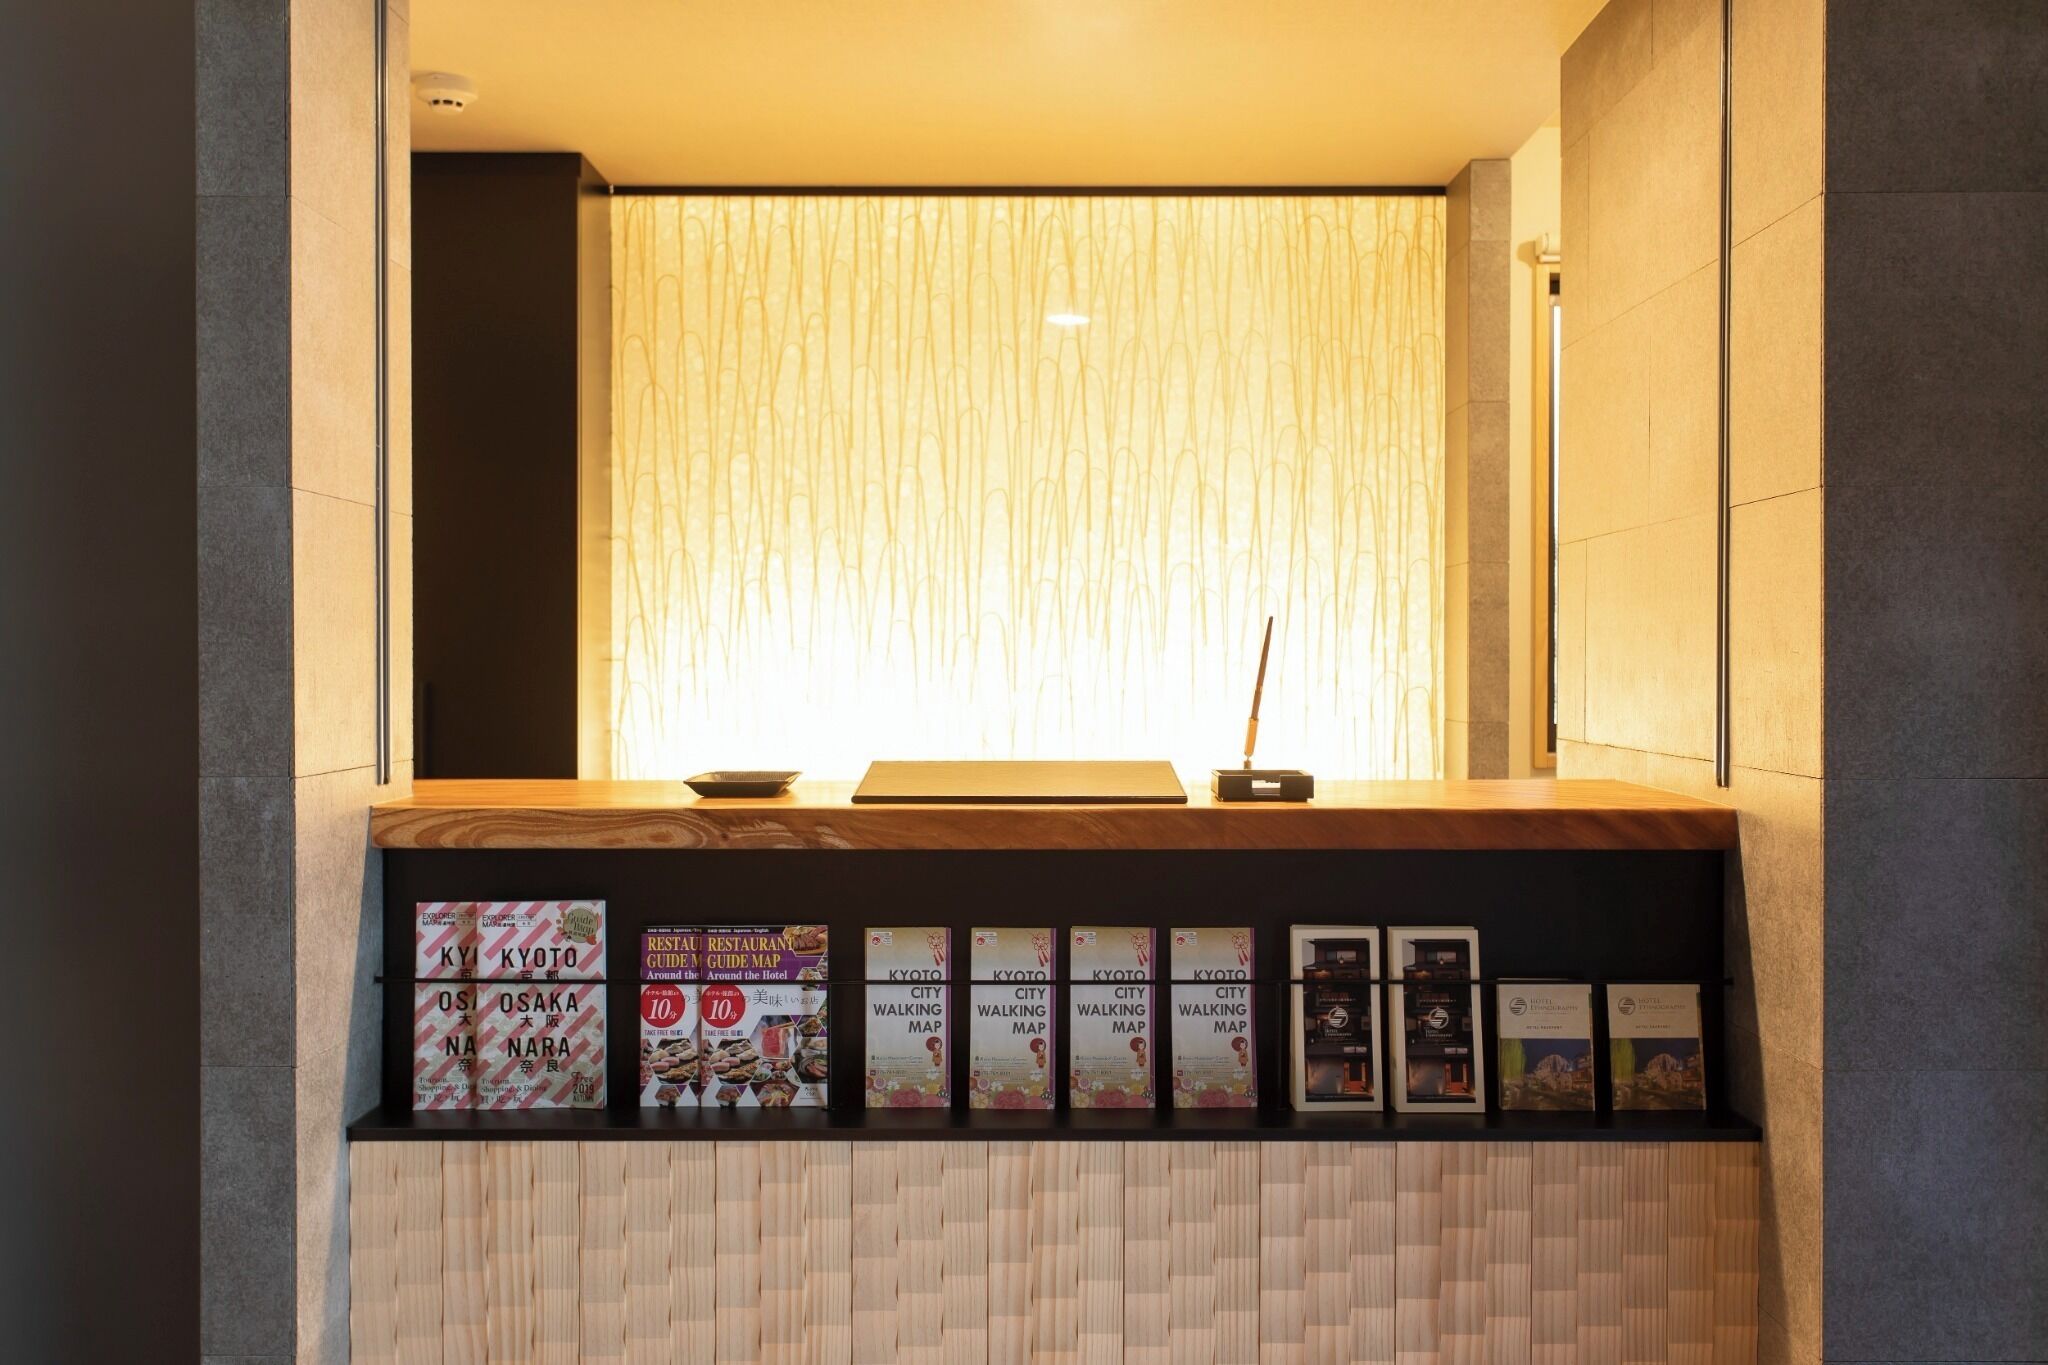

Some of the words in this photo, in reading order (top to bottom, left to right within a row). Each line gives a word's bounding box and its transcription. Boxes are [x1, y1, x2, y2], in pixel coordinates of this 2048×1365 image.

[648, 936, 702, 951] RESTAU
[708, 937, 794, 952] RESTAURANT
[501, 947, 577, 968] KYOTO
[647, 953, 688, 968] GUIDE
[707, 954, 748, 969] GUIDE
[752, 954, 781, 968] MAP
[647, 970, 681, 980] Around
[685, 970, 699, 980] the
[706, 970, 742, 980] Around
[747, 970, 760, 980] the
[762, 970, 787, 980] Hotel
[889, 969, 942, 980] KYOTO
[993, 970, 1046, 980] KYOTO
[1093, 969, 1145, 980] KYOTO
[1194, 969, 1247, 980] KYOTO
[911, 987, 942, 999] CITY
[1015, 988, 1046, 1000] CITY
[1114, 987, 1145, 999] CITY
[1215, 987, 1246, 999] CITY
[500, 992, 578, 1012] OSAKA
[873, 1003, 942, 1016] WALKING
[978, 1004, 1046, 1017] WALKING
[1078, 1003, 1146, 1016] WALKING
[1179, 1003, 1247, 1016] WALKING
[520, 1014, 560, 1028] 大阪
[908, 1021, 942, 1033] MAP
[1112, 1021, 1146, 1033] MAP
[1213, 1021, 1247, 1033] MAP
[1012, 1022, 1046, 1034] MAP
[507, 1037, 571, 1058] NARA
[520, 1060, 560, 1073] 奈良
[571, 1071, 594, 1083] Free
[573, 1083, 594, 1094] 2019
